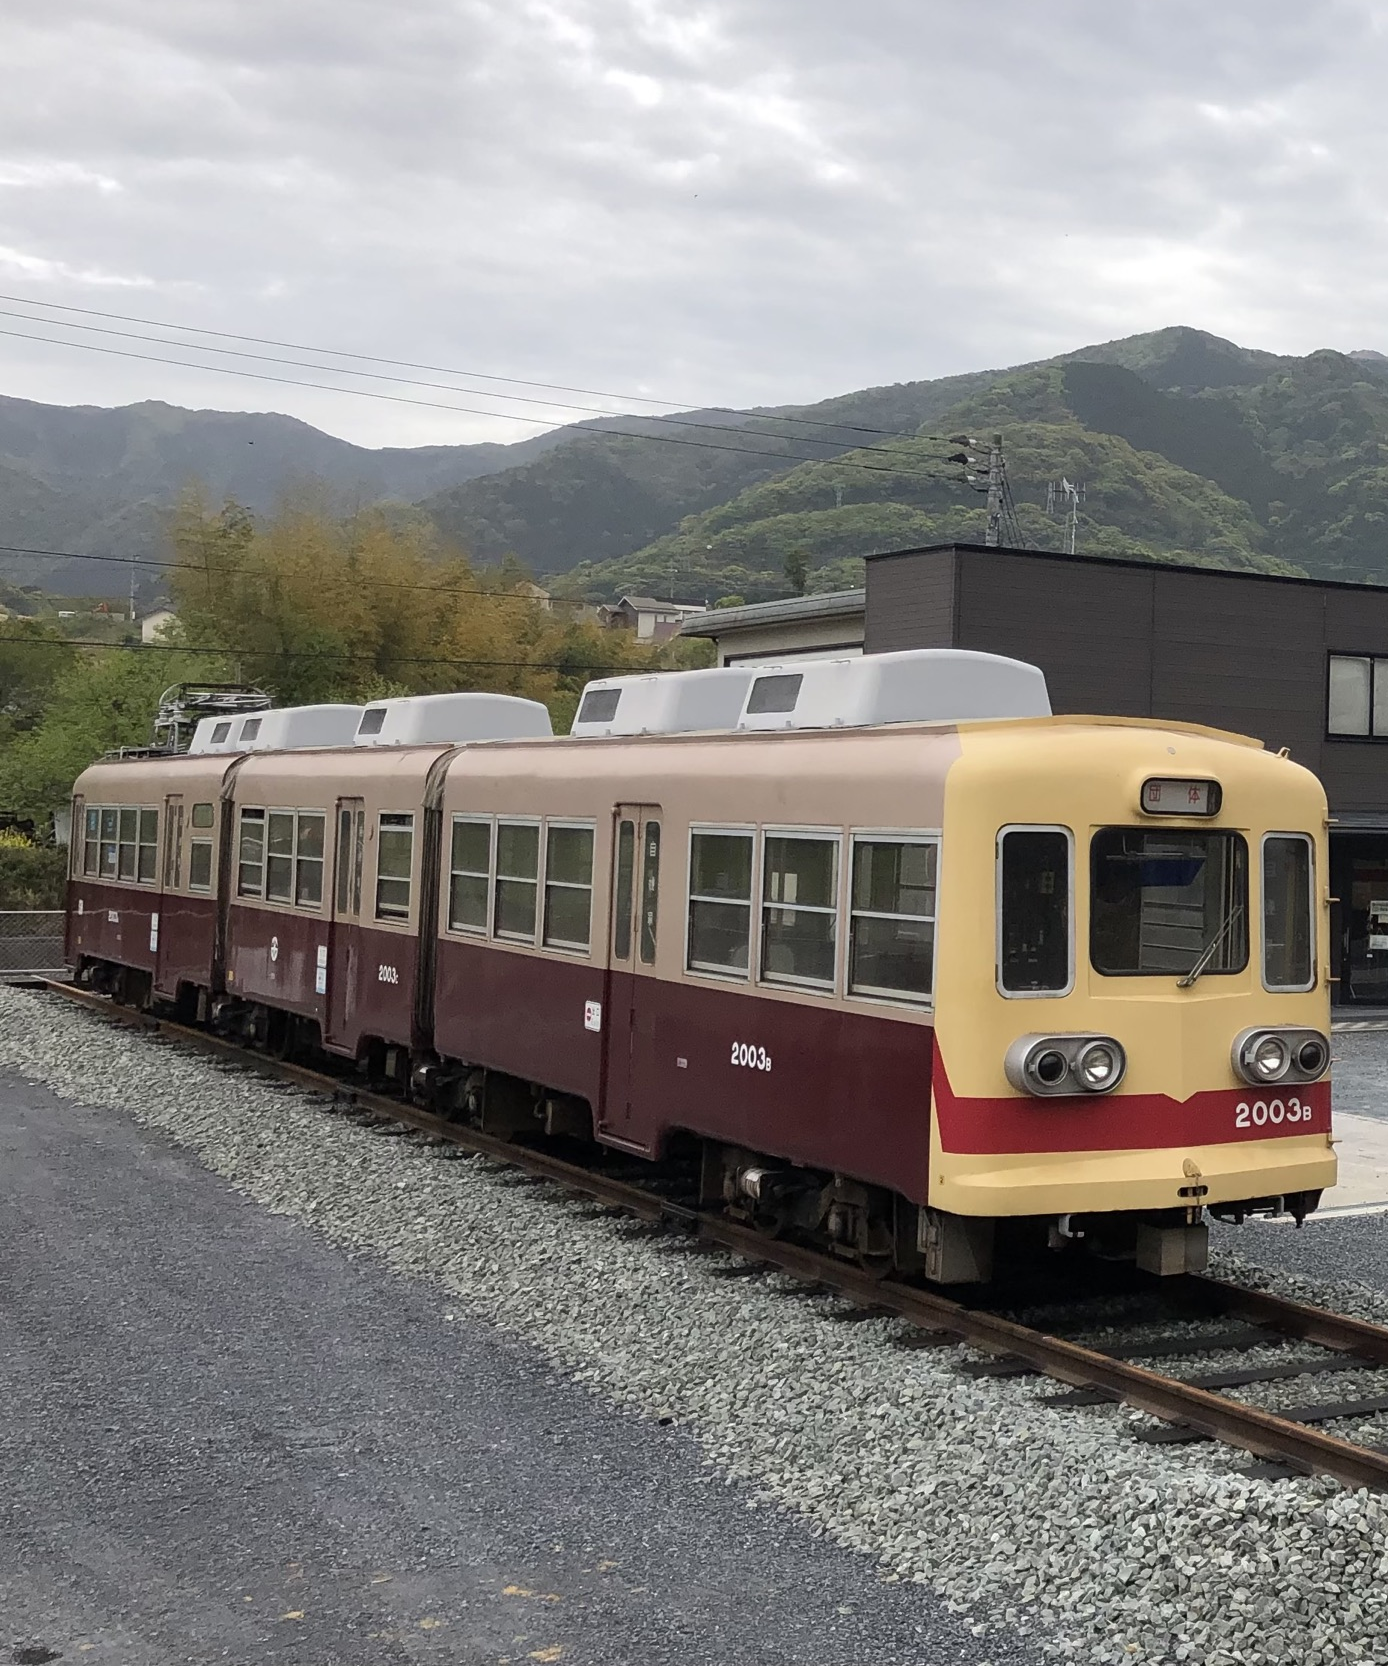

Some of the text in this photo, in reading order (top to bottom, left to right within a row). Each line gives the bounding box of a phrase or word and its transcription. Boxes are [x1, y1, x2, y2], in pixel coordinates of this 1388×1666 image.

[1149, 784, 1201, 804] 団体
[730, 1041, 773, 1072] 2003B
[1235, 1097, 1312, 1128] 2003B
